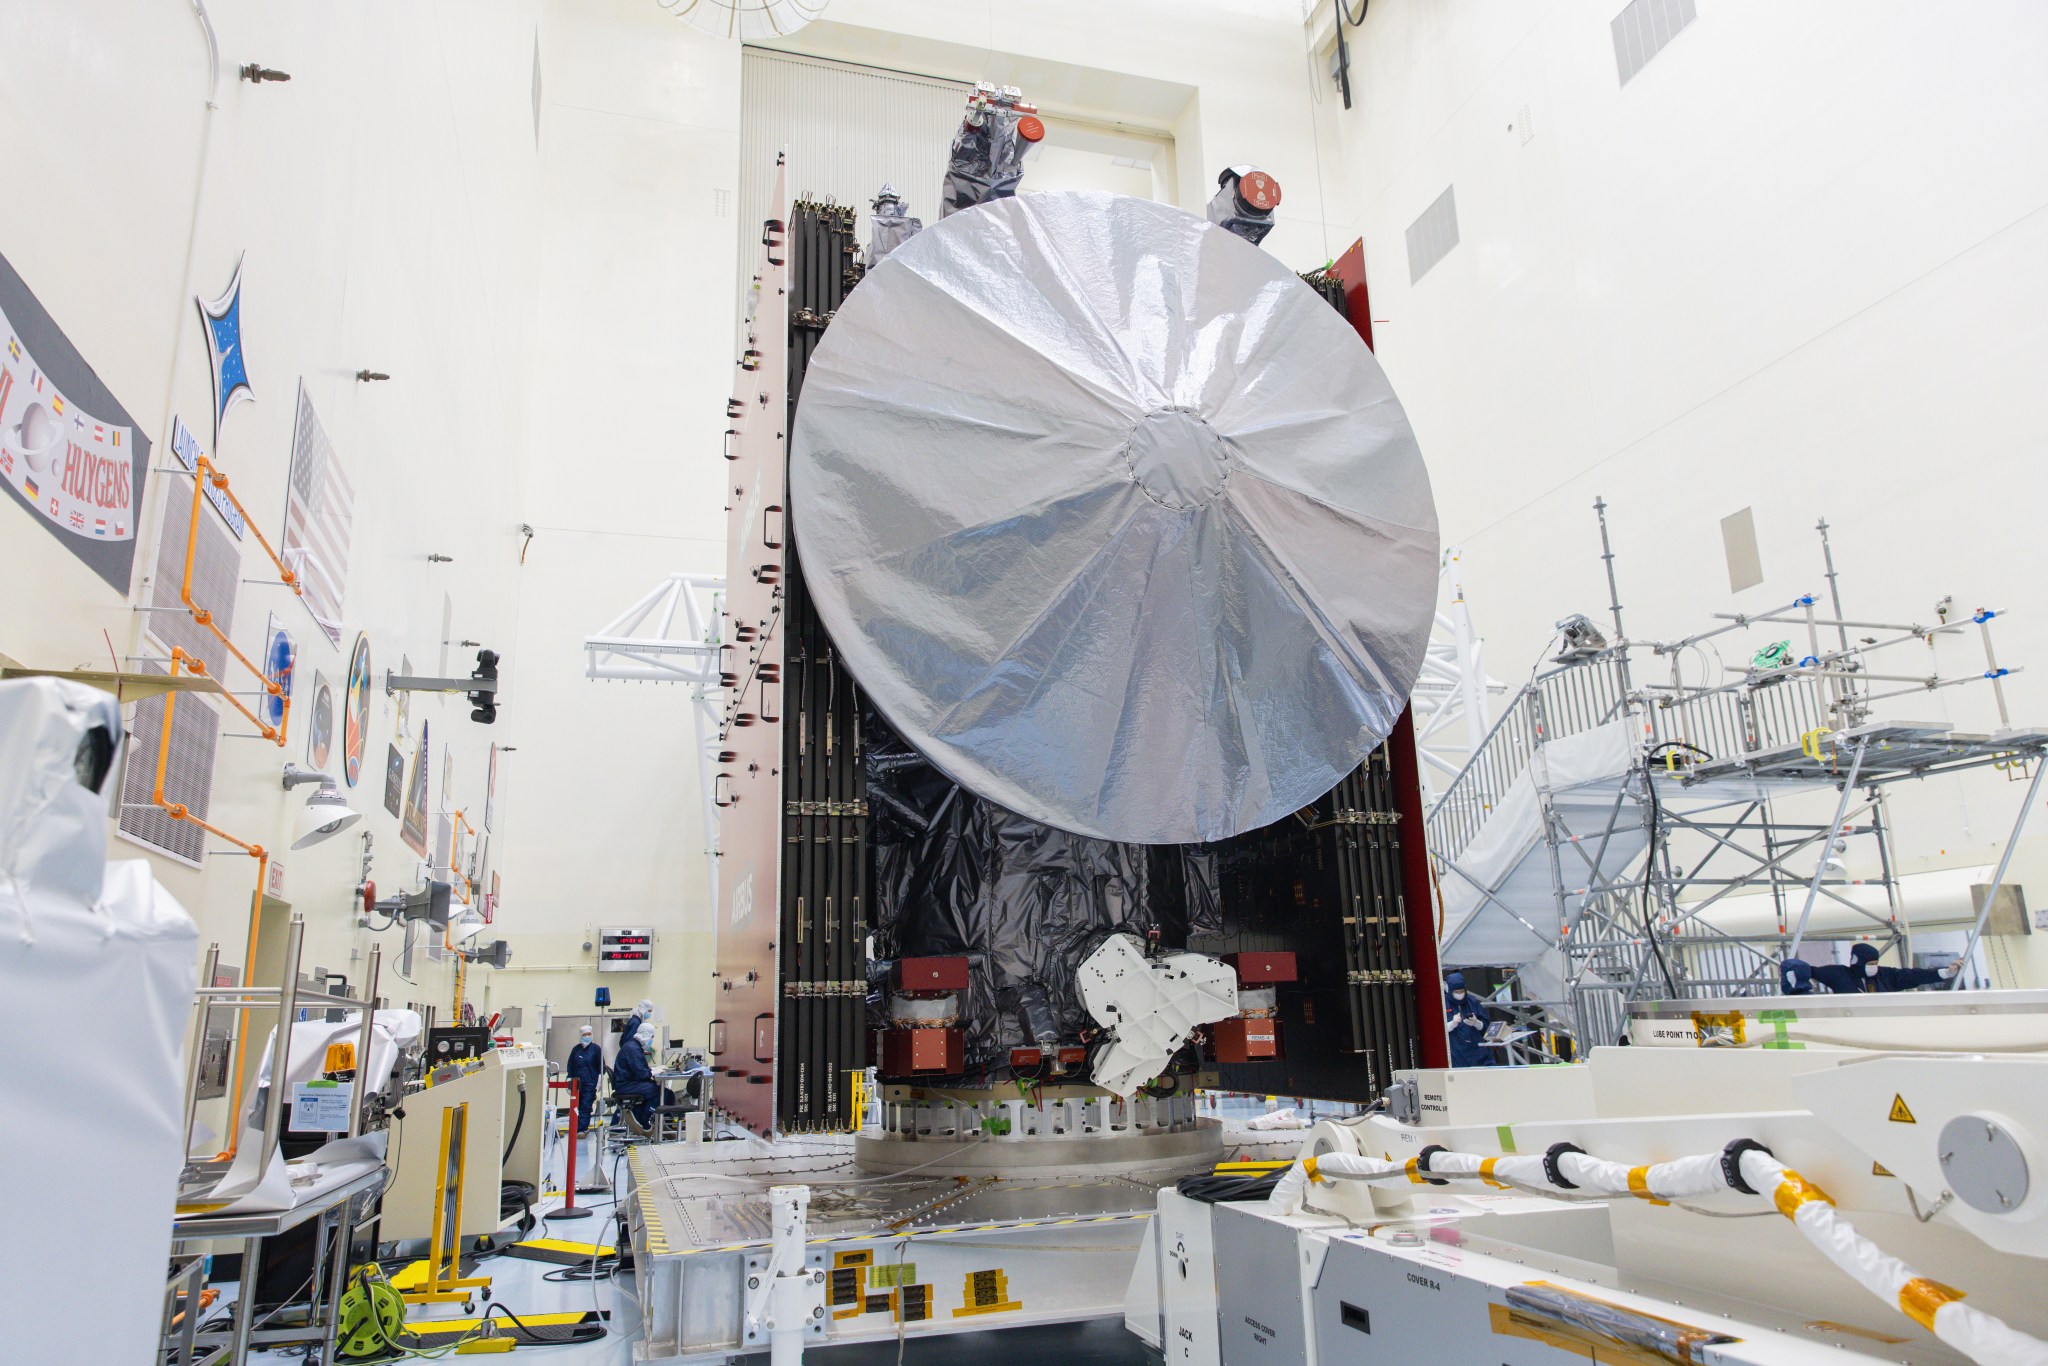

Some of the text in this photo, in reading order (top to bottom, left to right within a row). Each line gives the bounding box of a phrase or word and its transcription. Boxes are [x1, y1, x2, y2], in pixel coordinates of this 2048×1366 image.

[61, 439, 130, 509] HUYGENS
[271, 867, 283, 891] EXIT
[731, 872, 753, 926] AIRBUS
[1653, 1030, 1666, 1039] LUBE
[1666, 1031, 1683, 1040] POINT
[1424, 1094, 1443, 1102] REMOTE
[1420, 1104, 1442, 1112] CONTROL
[1406, 1272, 1441, 1291] COVER R-4
[1179, 1326, 1193, 1343] JACK
[1245, 1316, 1276, 1338] ACCESS COVER
[1254, 1332, 1267, 1346] RIGHT
[1184, 1347, 1189, 1358] C
